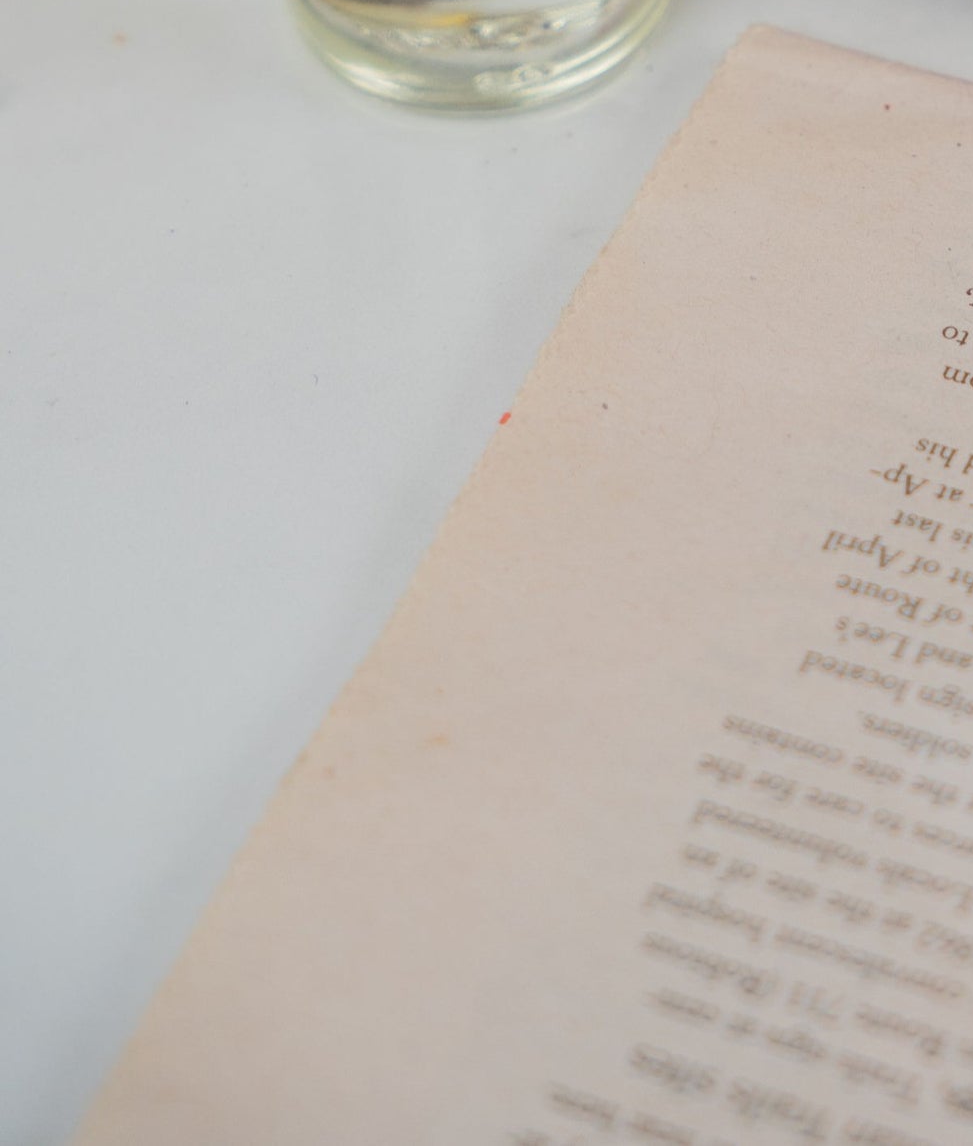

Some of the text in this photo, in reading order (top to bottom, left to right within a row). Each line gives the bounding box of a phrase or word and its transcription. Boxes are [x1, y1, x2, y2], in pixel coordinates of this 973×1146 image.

[941, 325, 969, 346] to
[914, 438, 957, 468] his
[871, 462, 928, 496] Ap-
[935, 483, 964, 502] at
[891, 509, 942, 543] last
[820, 529, 902, 568] April
[900, 554, 941, 575] of
[834, 572, 924, 622] Route
[921, 601, 965, 625] of
